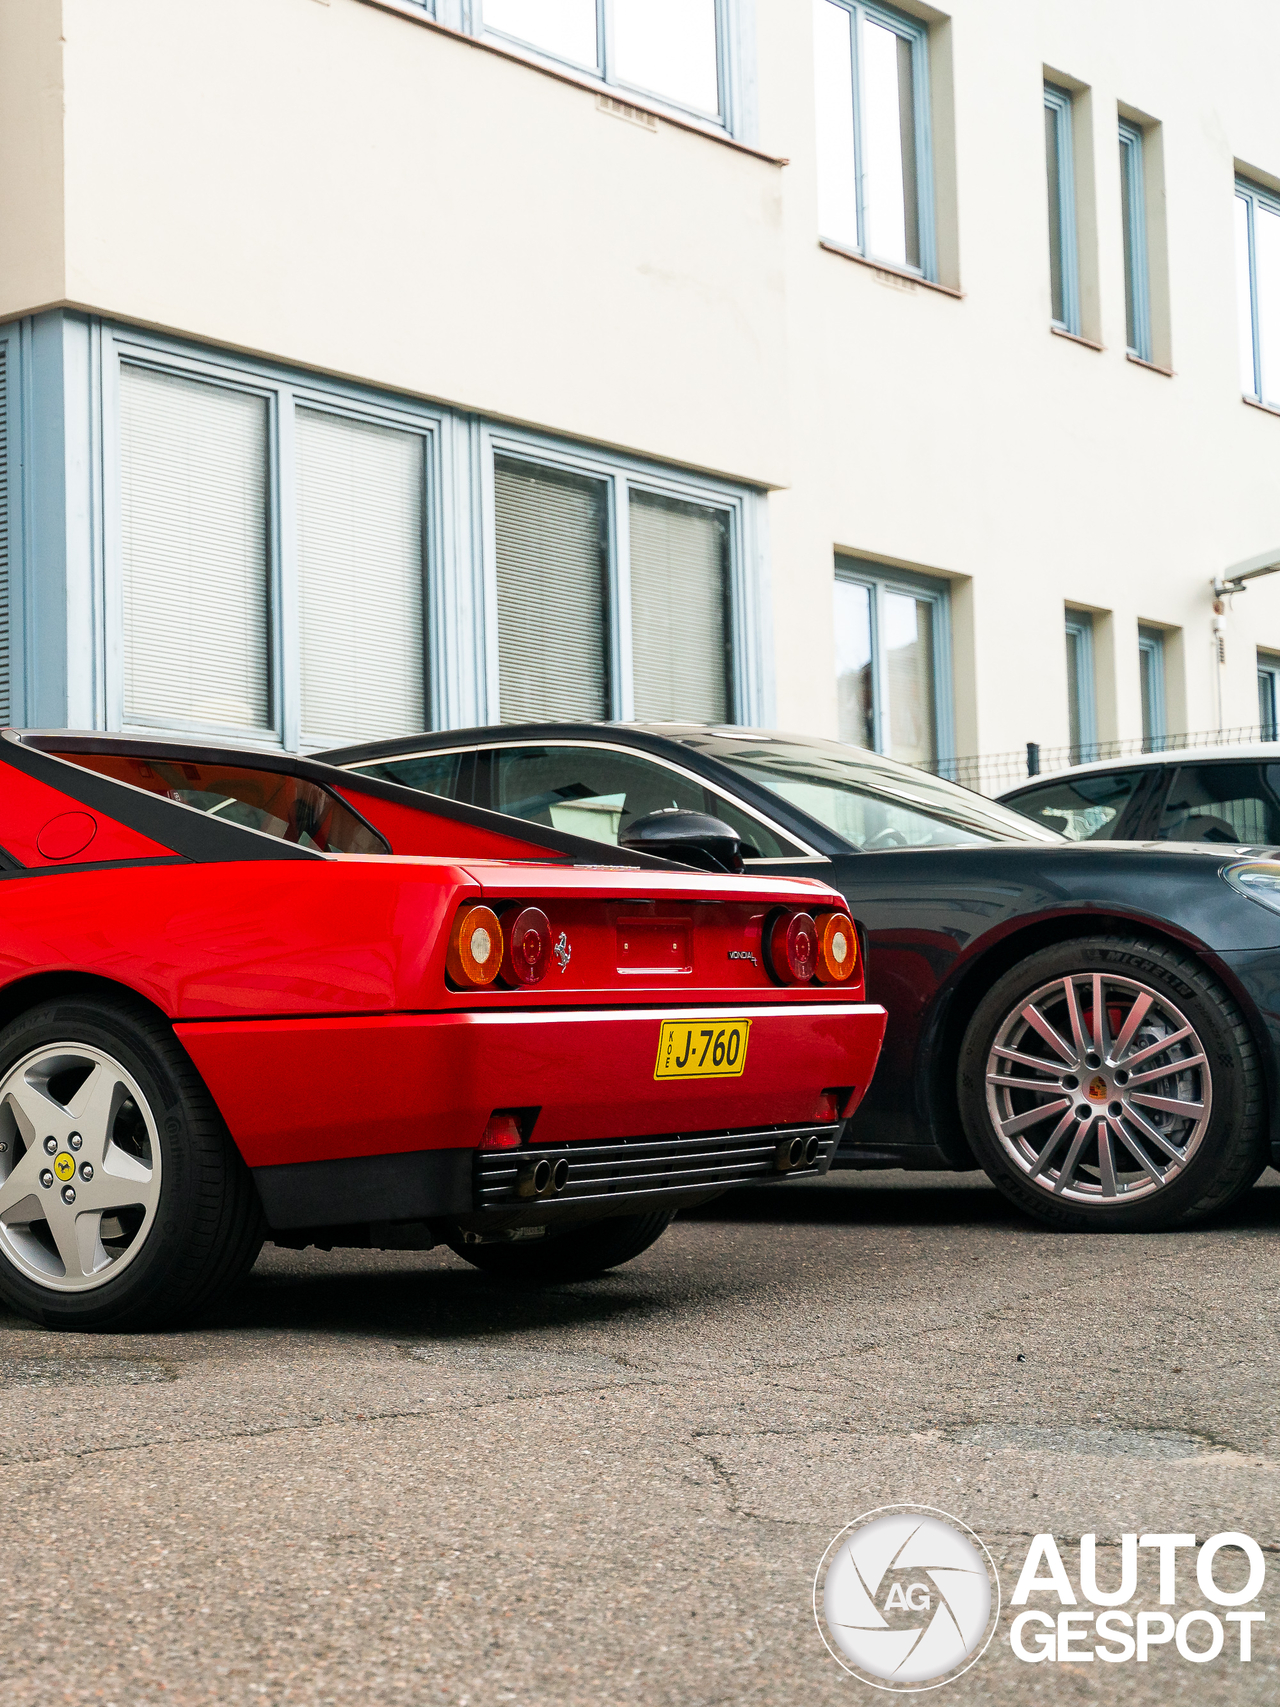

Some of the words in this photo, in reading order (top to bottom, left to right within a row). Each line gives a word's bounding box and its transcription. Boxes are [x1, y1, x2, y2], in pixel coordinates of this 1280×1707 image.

[1106, 951, 1193, 998] MICHELIN
[665, 1030, 675, 1069] KOE
[675, 1028, 741, 1069] J-760
